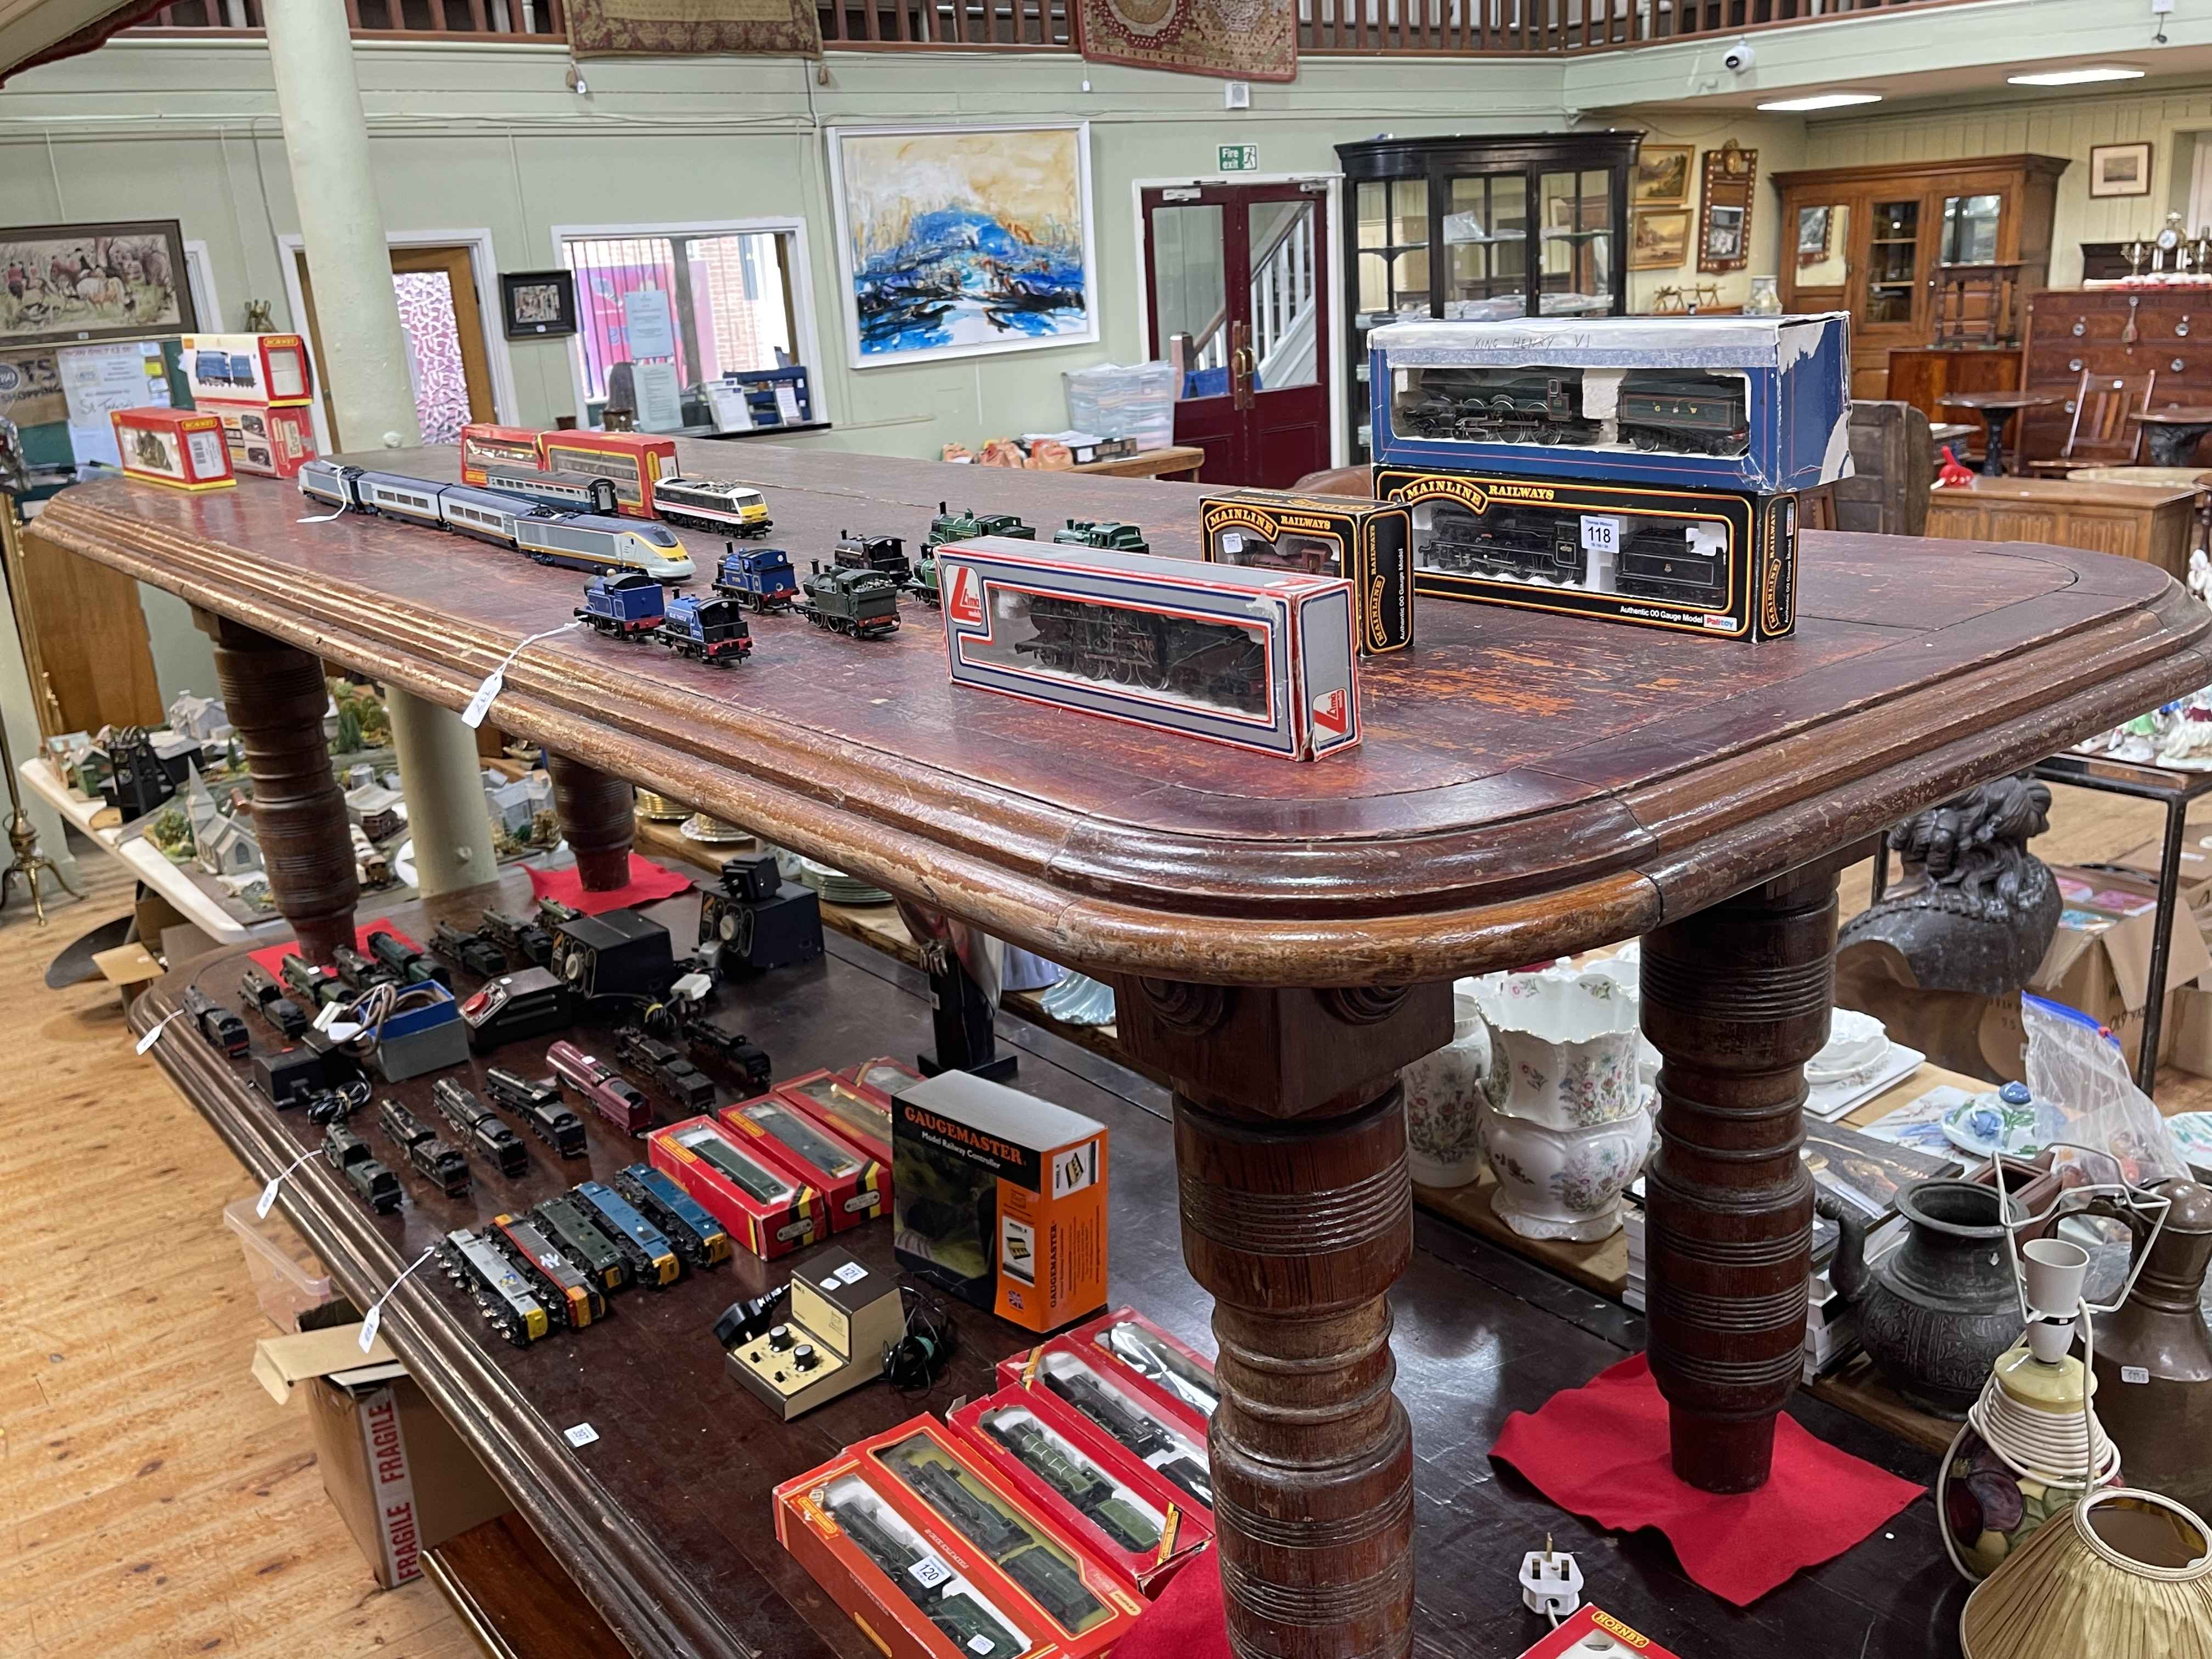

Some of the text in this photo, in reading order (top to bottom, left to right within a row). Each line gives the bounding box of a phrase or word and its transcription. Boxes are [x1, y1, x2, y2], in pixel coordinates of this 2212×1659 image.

[1222, 148, 1239, 158] Fire
[1222, 159, 1239, 169] exit
[1474, 337, 1498, 349] KING
[1512, 333, 1554, 349] HENRY
[1406, 480, 1554, 506] MAINLINE RAILWAYS
[1209, 508, 1331, 535] MAINLINE RAILWAYS
[1588, 526, 1611, 543] 118
[1767, 563, 1779, 624] MAINLINE
[1371, 579, 1384, 644] MAINLINE
[1620, 606, 1649, 617] Authentic
[1660, 611, 1681, 622] Gauge
[1682, 614, 1703, 624] Model
[1706, 617, 1734, 628] Palitoy
[904, 1106, 1023, 1165] GAUGEMASTER
[922, 1131, 1001, 1169] Model Railway Controller
[843, 1267, 859, 1278] 121
[368, 1400, 405, 1485] FRAGILE
[386, 1502, 421, 1581] FRAGILE
[919, 1564, 940, 1581] 120
[1595, 1612, 1645, 1646] HORNBY
